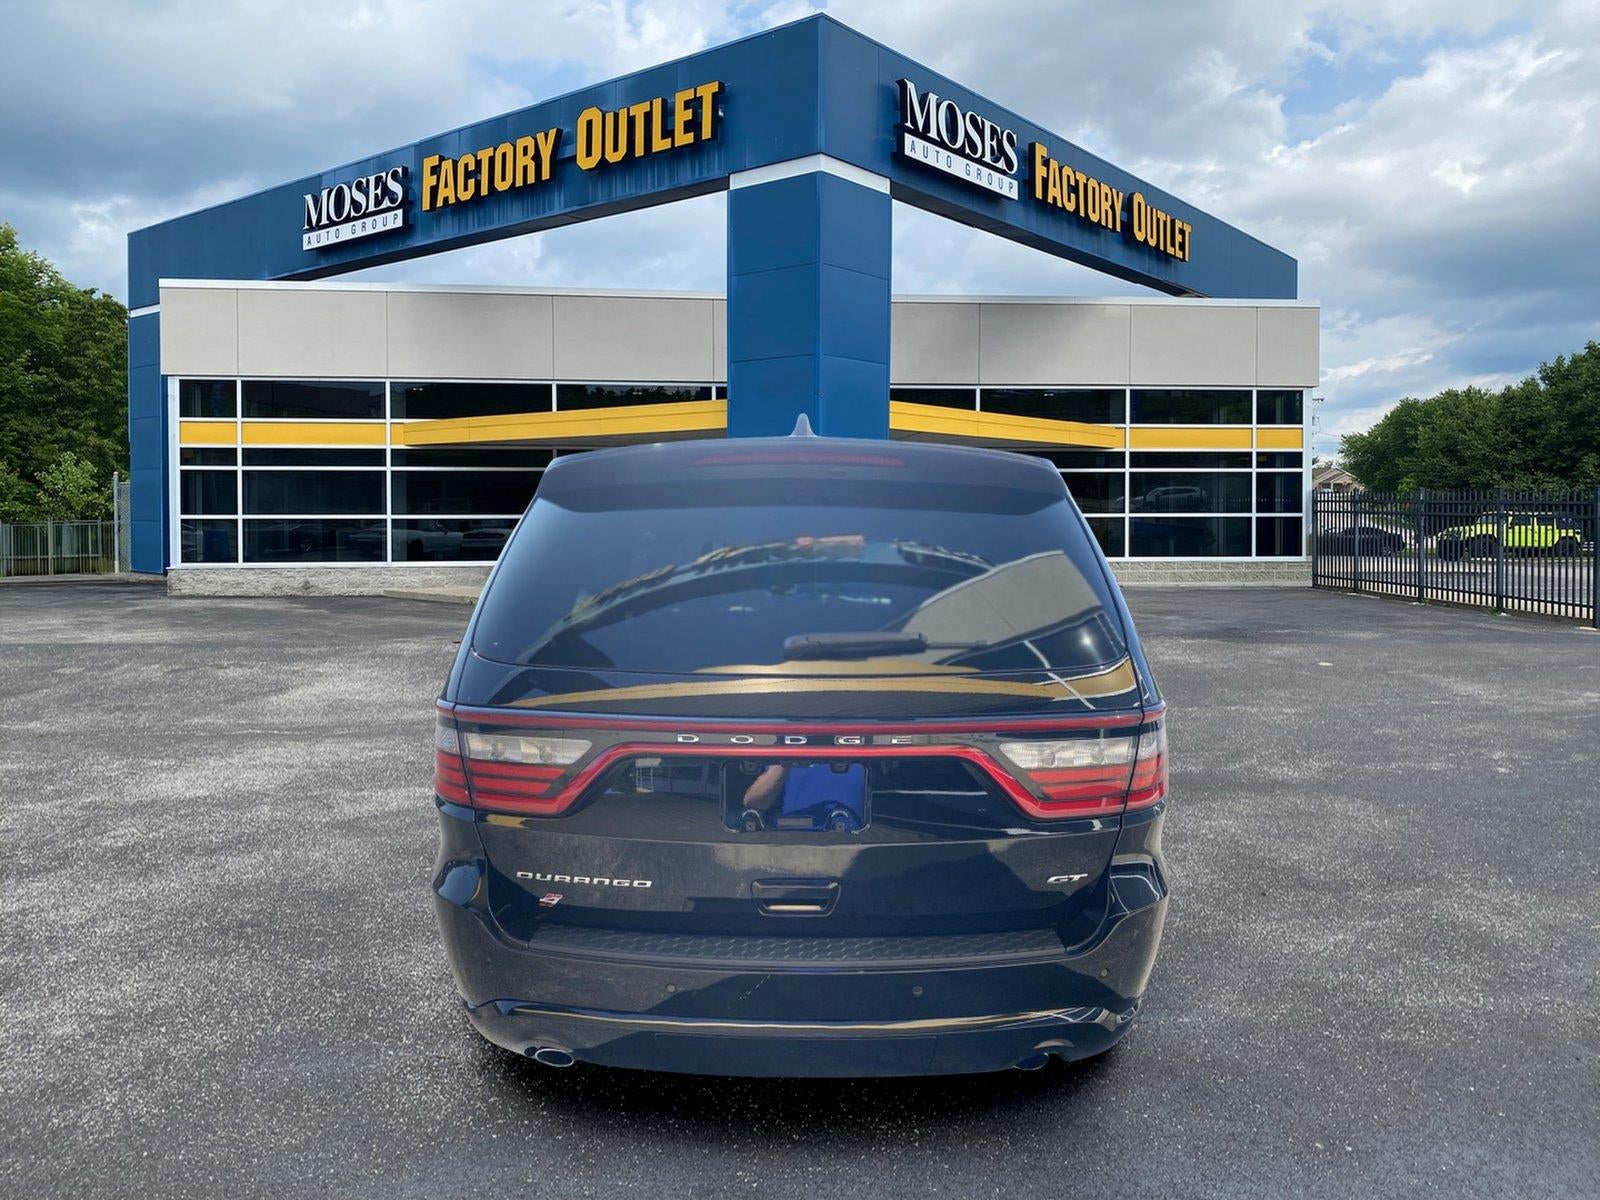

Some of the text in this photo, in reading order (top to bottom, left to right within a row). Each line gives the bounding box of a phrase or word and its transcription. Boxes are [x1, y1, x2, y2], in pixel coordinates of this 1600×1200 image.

[422, 80, 720, 212] FACTORY OUTLET
[904, 78, 1018, 175] MOSES
[909, 140, 1015, 194] AUTO GROUP
[303, 167, 404, 230] MOSES
[1034, 142, 1192, 262] FACTORY OUTLET
[306, 212, 400, 247] AUTO GROUP
[677, 733, 913, 745] DODGE
[516, 871, 653, 888] DURANGO
[1047, 873, 1089, 884] GT
